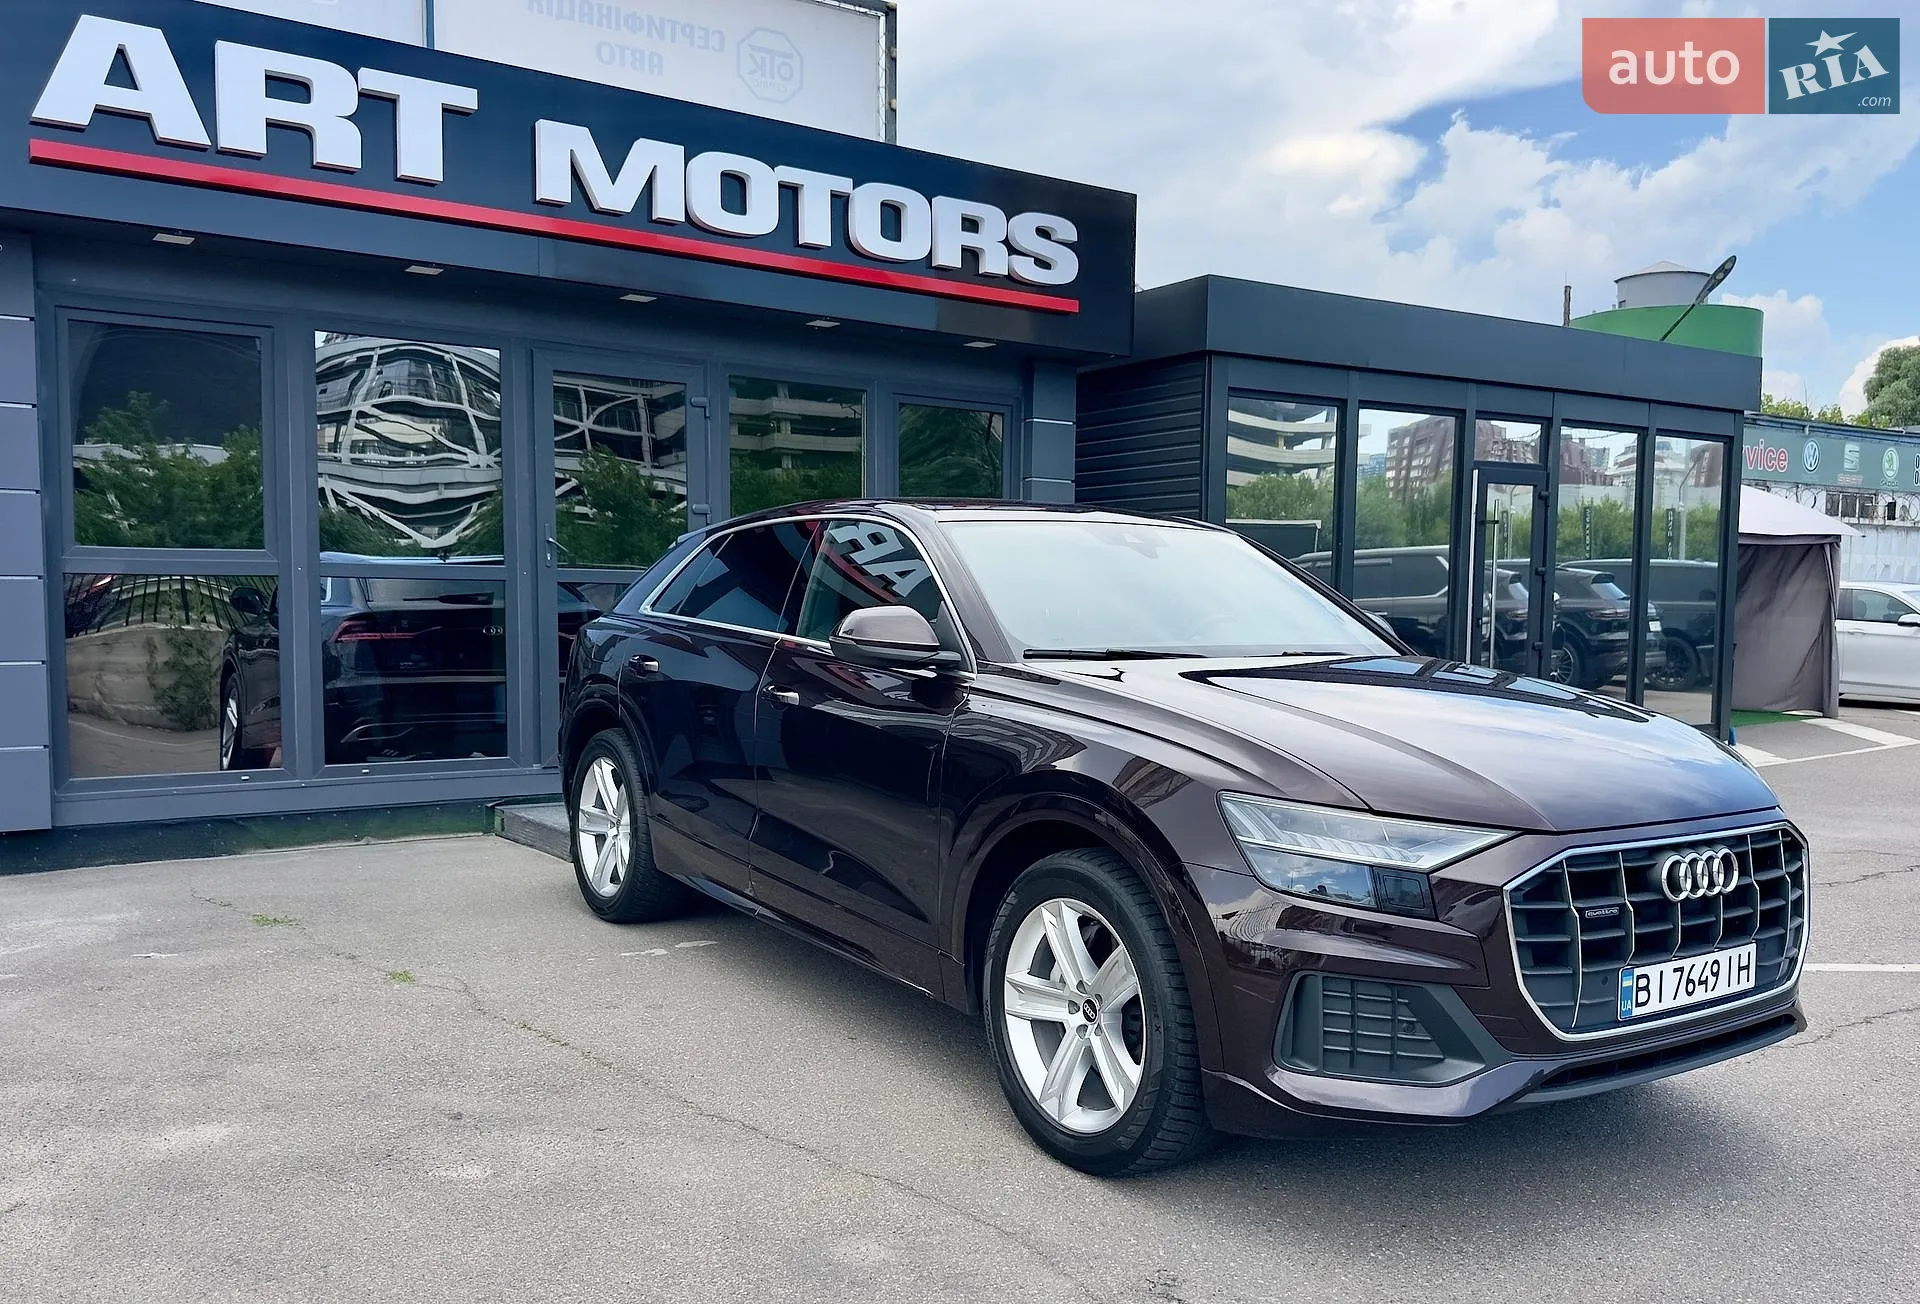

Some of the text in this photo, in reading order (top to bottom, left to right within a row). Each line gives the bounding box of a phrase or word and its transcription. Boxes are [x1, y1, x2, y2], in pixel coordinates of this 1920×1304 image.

[30, 14, 1079, 286] ART MOTORS
[1743, 438, 1789, 473] vice
[1634, 951, 1751, 1008] BI 7649 IH
[1621, 1000, 1632, 1012] UA
